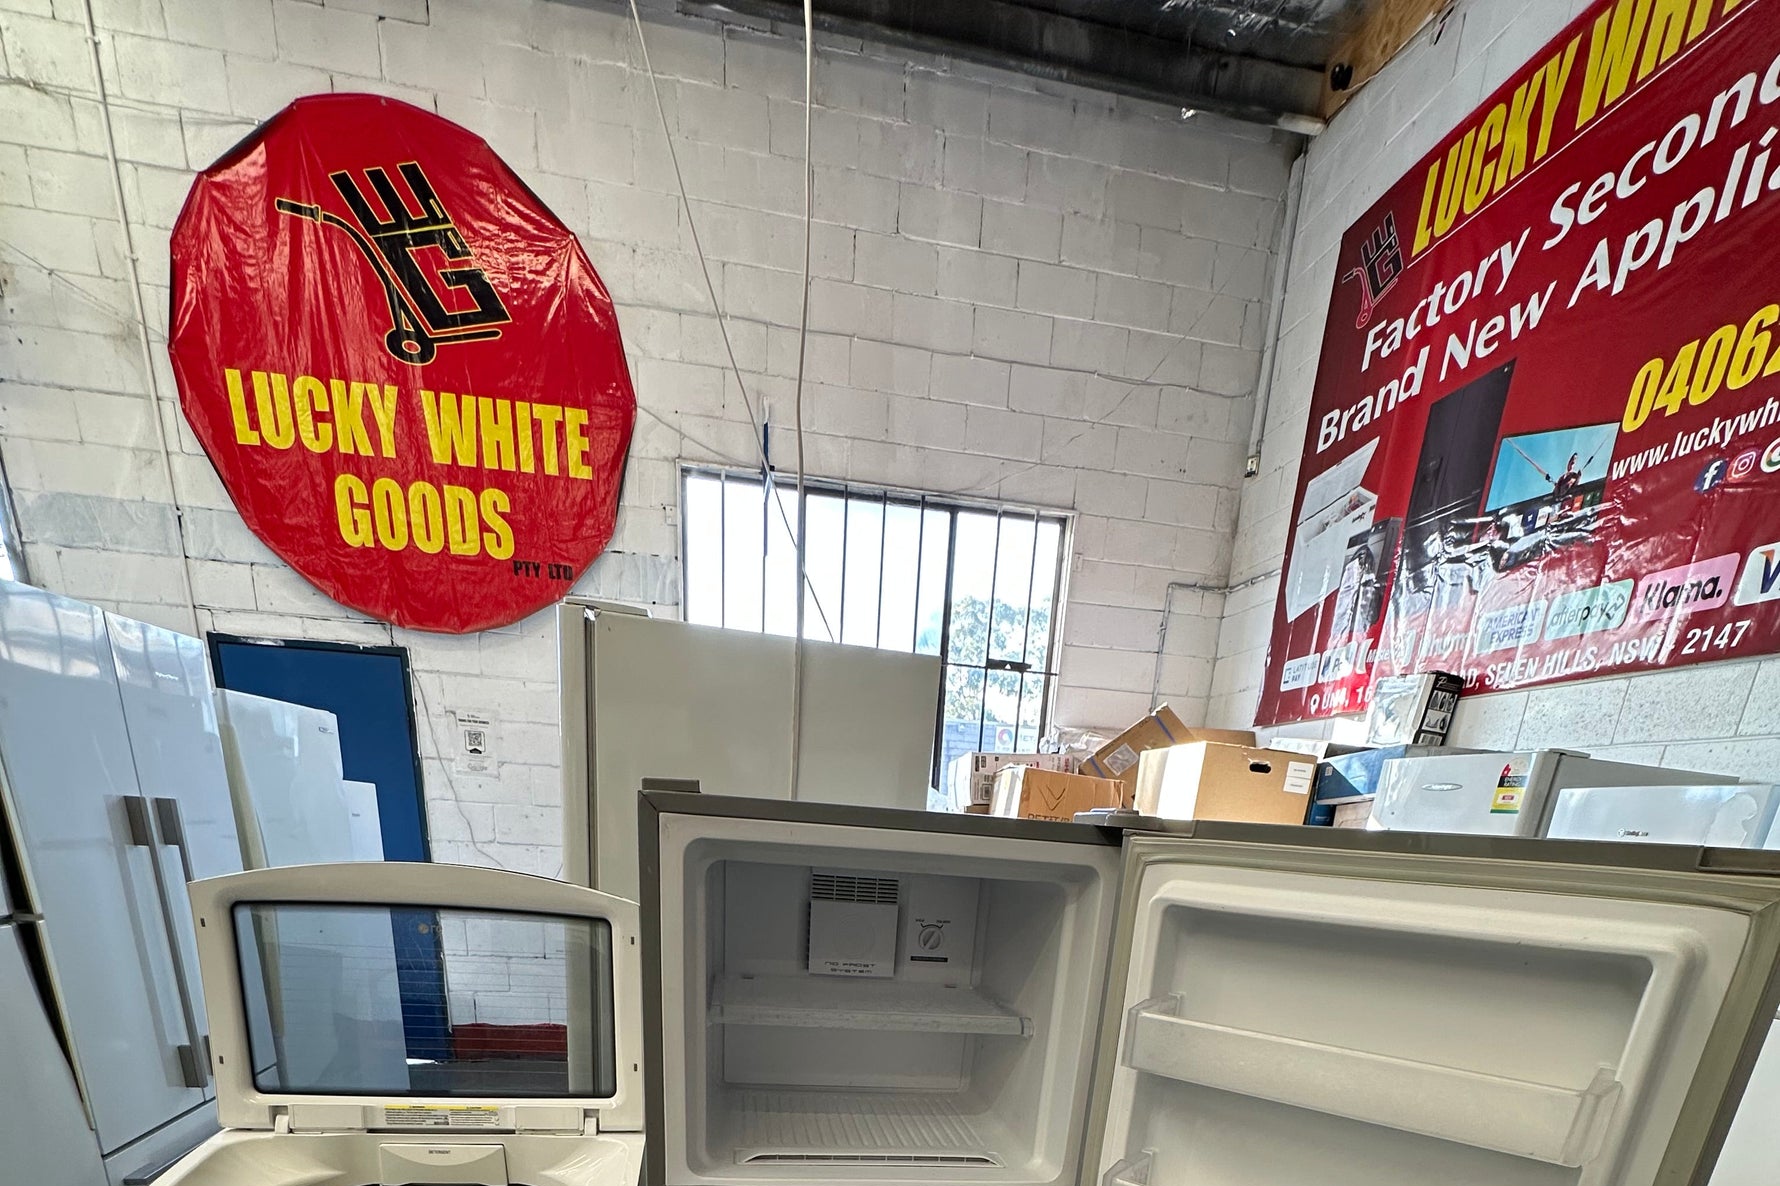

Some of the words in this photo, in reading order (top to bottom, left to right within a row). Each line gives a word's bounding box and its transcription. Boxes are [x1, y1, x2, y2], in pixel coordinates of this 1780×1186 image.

[1412, 33, 1582, 258] LUCKY
[1575, 0, 1742, 131] WH
[1361, 227, 1531, 373] Factory
[1316, 345, 1430, 454] Brand
[1439, 280, 1557, 382] New
[225, 368, 398, 458] LUCKY
[420, 389, 592, 480] WHITE
[1612, 397, 1780, 481] www.luckywh
[335, 473, 515, 560] GOODS
[513, 560, 540, 579] PTY
[548, 563, 572, 581] LTD
[1681, 619, 1751, 655] 2147
